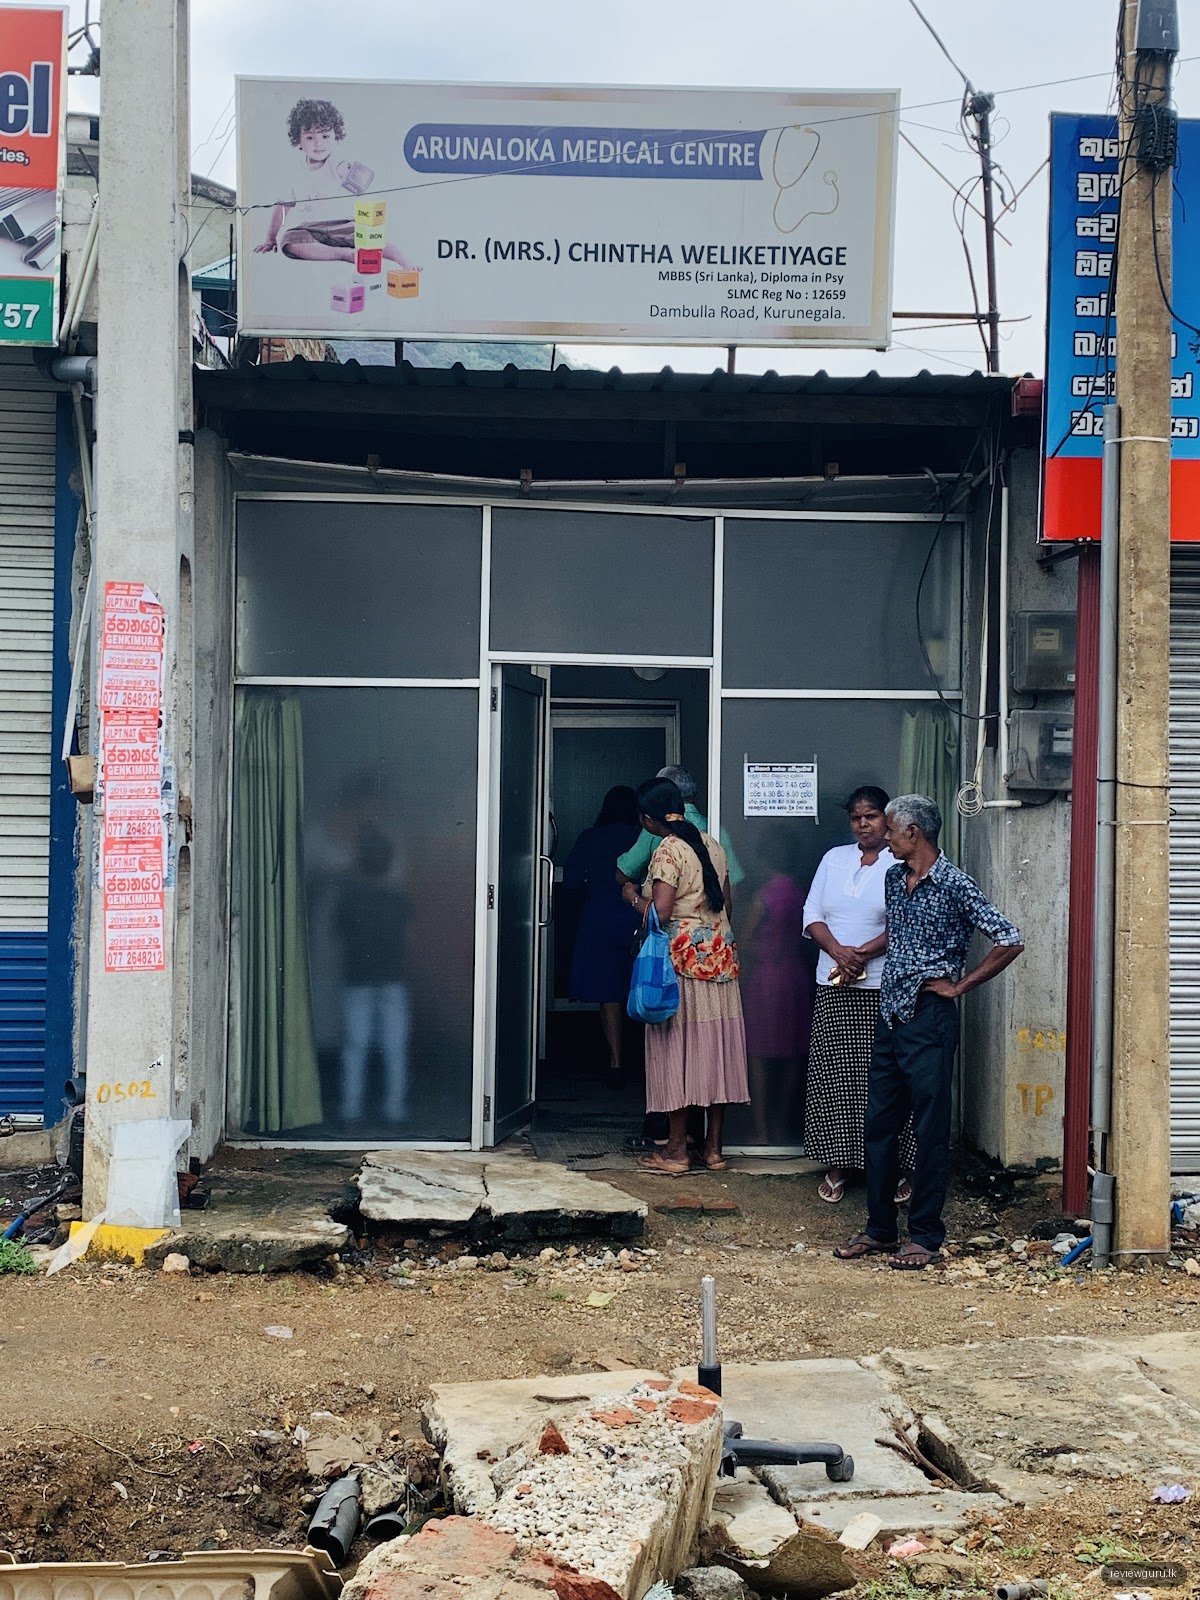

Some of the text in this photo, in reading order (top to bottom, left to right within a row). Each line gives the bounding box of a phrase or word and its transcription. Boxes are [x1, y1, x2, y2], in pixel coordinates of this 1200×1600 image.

[0, 149, 29, 164] ies,
[412, 135, 755, 167] ARUNALOKA MEDICAL CENTRE
[437, 237, 847, 266] DR. (MRS.) CHINTHA WELIKETIYAGE
[658, 271, 844, 284] MBBS (Sri Lanka), Diploma in Psy
[727, 289, 759, 300] SLMC
[762, 289, 782, 301] Reg
[786, 289, 801, 300] No
[812, 289, 846, 300] 12659
[0, 303, 40, 329] 57
[650, 304, 846, 322] Dambulla Road, Kurunegala.
[106, 634, 160, 647] GENKIMURA
[103, 691, 157, 706] 077 2648212
[107, 764, 159, 776] GENKIMURA
[108, 822, 161, 835] 077 2648212
[107, 873, 160, 892] ජපානයට
[107, 894, 161, 905] GENKIMURA
[108, 951, 162, 965] 077 2648212
[1016, 1083, 1054, 1117] TP
